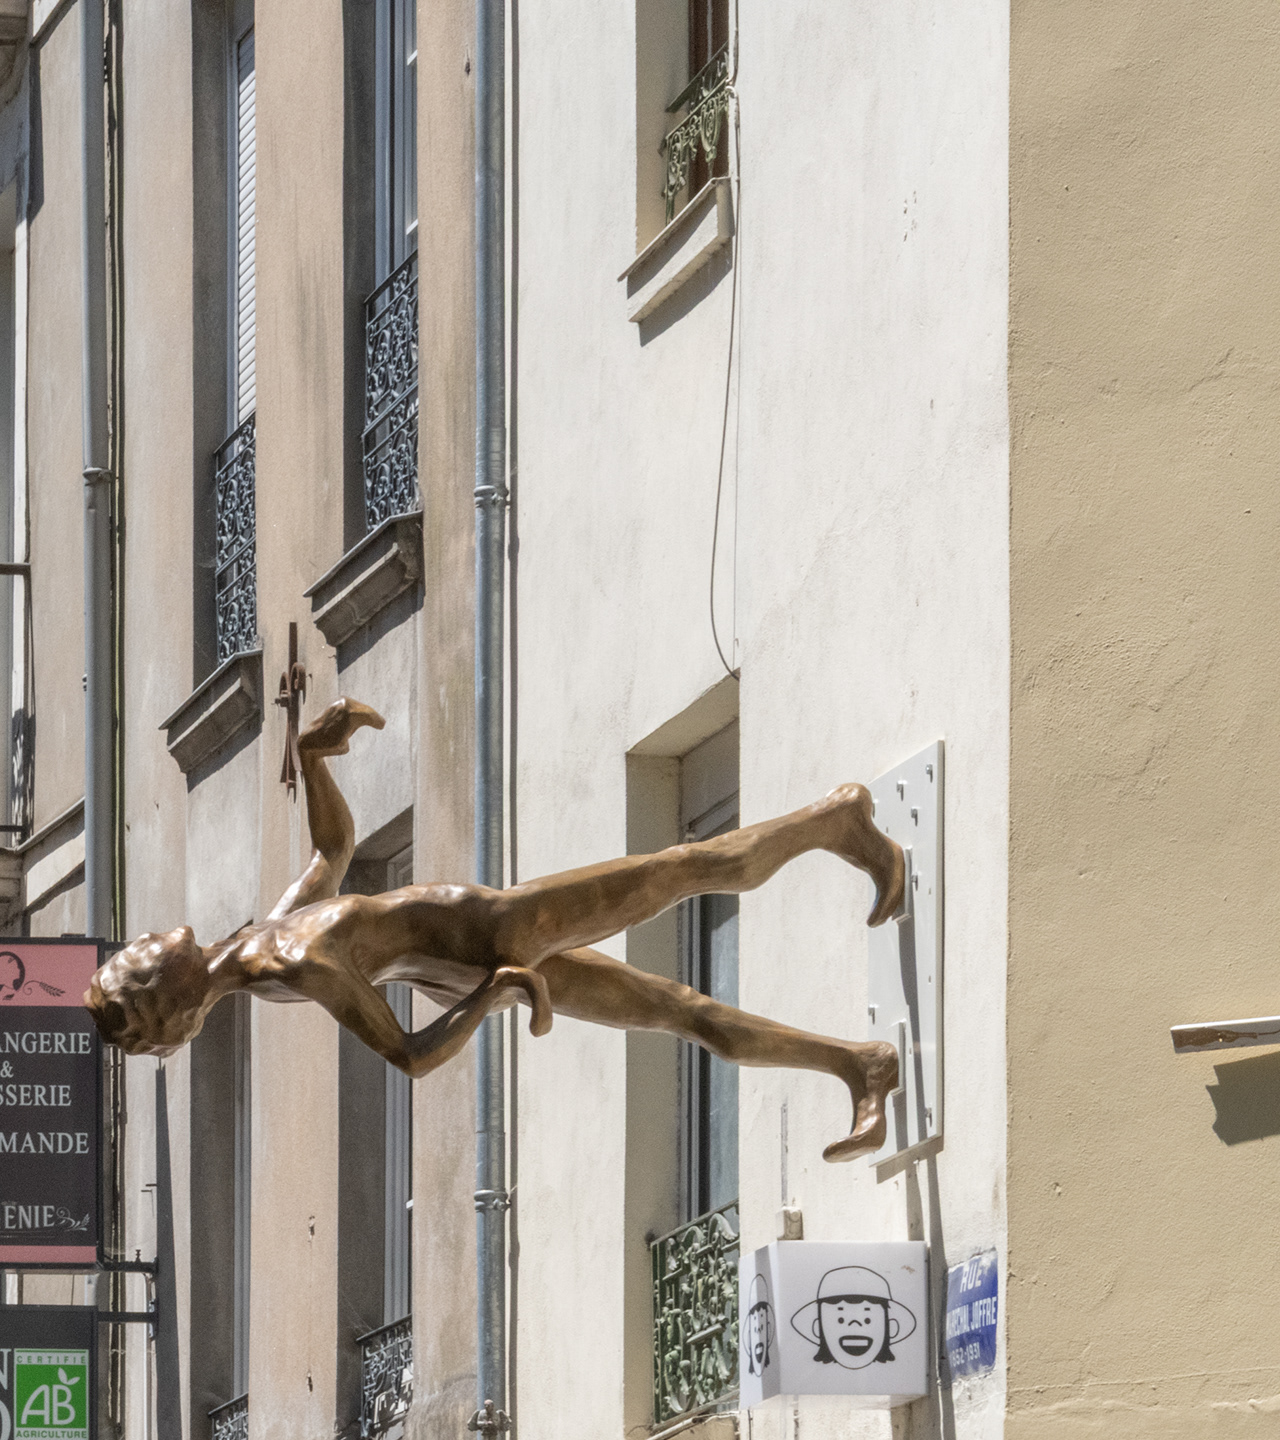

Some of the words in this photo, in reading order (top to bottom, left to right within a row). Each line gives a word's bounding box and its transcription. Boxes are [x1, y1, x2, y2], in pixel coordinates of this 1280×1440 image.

[0, 1060, 14, 1078] &
[960, 1263, 982, 1293] RUE
[970, 1296, 997, 1331] JOFFRE
[21, 1384, 76, 1425] AB
[16, 1430, 87, 1439] AGRICULTURE
